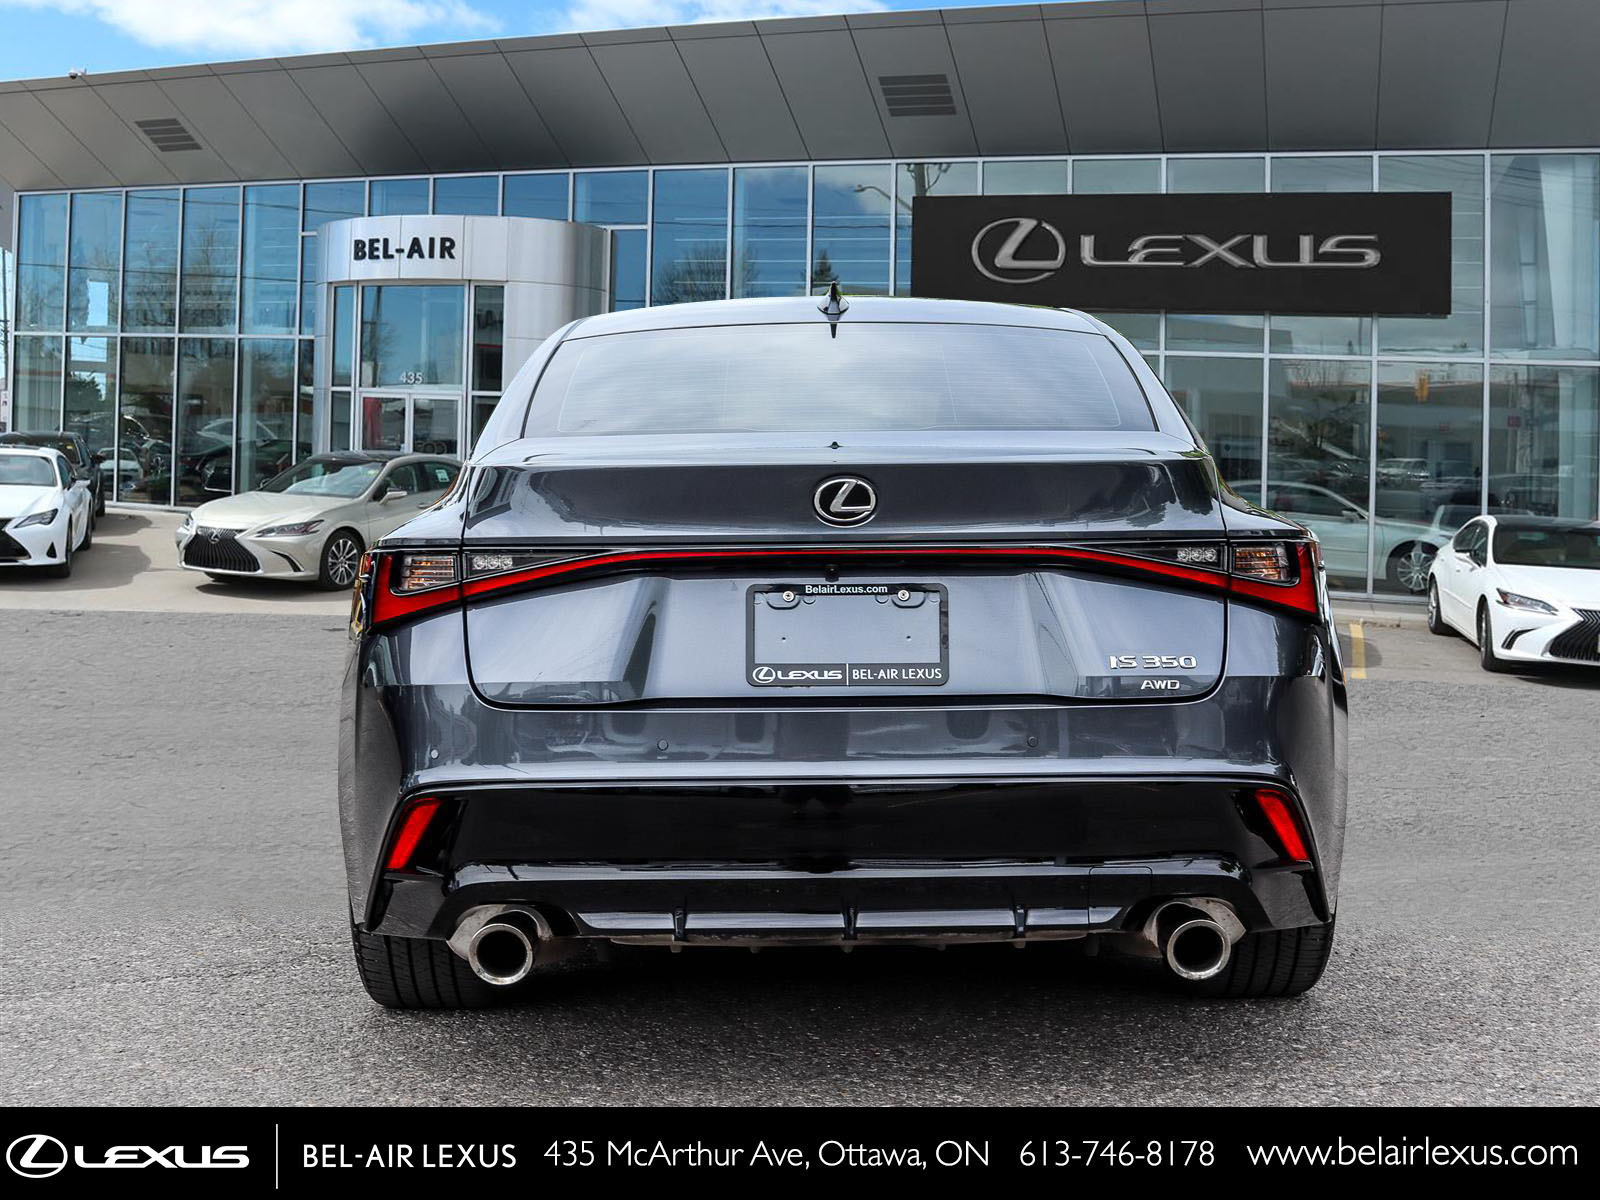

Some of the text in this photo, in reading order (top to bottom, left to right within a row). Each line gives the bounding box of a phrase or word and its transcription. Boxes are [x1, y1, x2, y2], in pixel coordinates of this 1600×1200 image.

[353, 236, 456, 261] BEL-AIR
[1080, 234, 1381, 268] LEXUS
[400, 371, 424, 385] 435
[805, 584, 888, 594] BelairLexus.com
[1109, 655, 1197, 669] IS 350
[777, 670, 842, 680] LEXUS
[852, 668, 942, 680] BEL-AIR LEXUS
[1140, 680, 1180, 690] AWD
